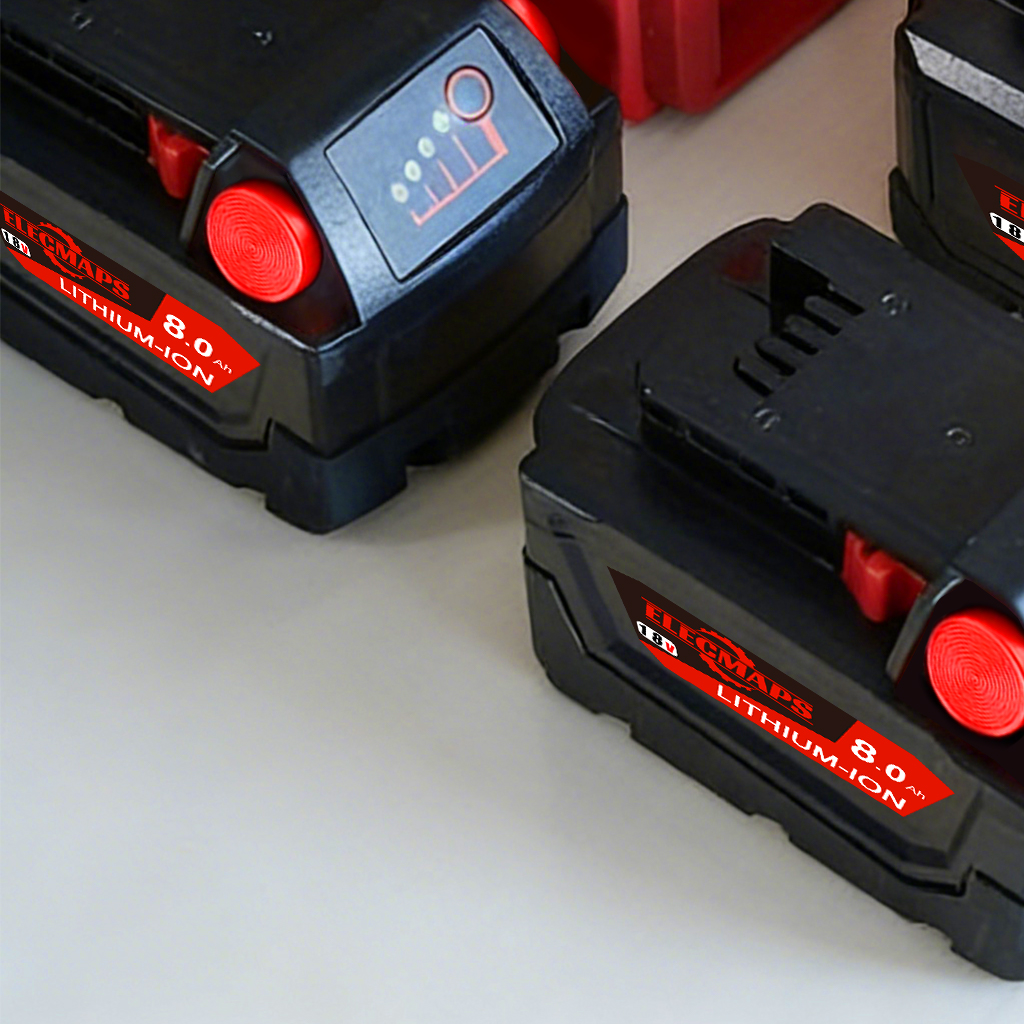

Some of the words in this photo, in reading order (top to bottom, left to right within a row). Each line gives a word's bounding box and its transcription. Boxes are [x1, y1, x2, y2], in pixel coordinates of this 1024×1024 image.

[3, 207, 130, 300] ELECMAPS
[61, 278, 214, 386] LITHIUM-ION
[645, 602, 814, 720] ELECMAPS
[718, 685, 907, 810] LITHIUM-ION
